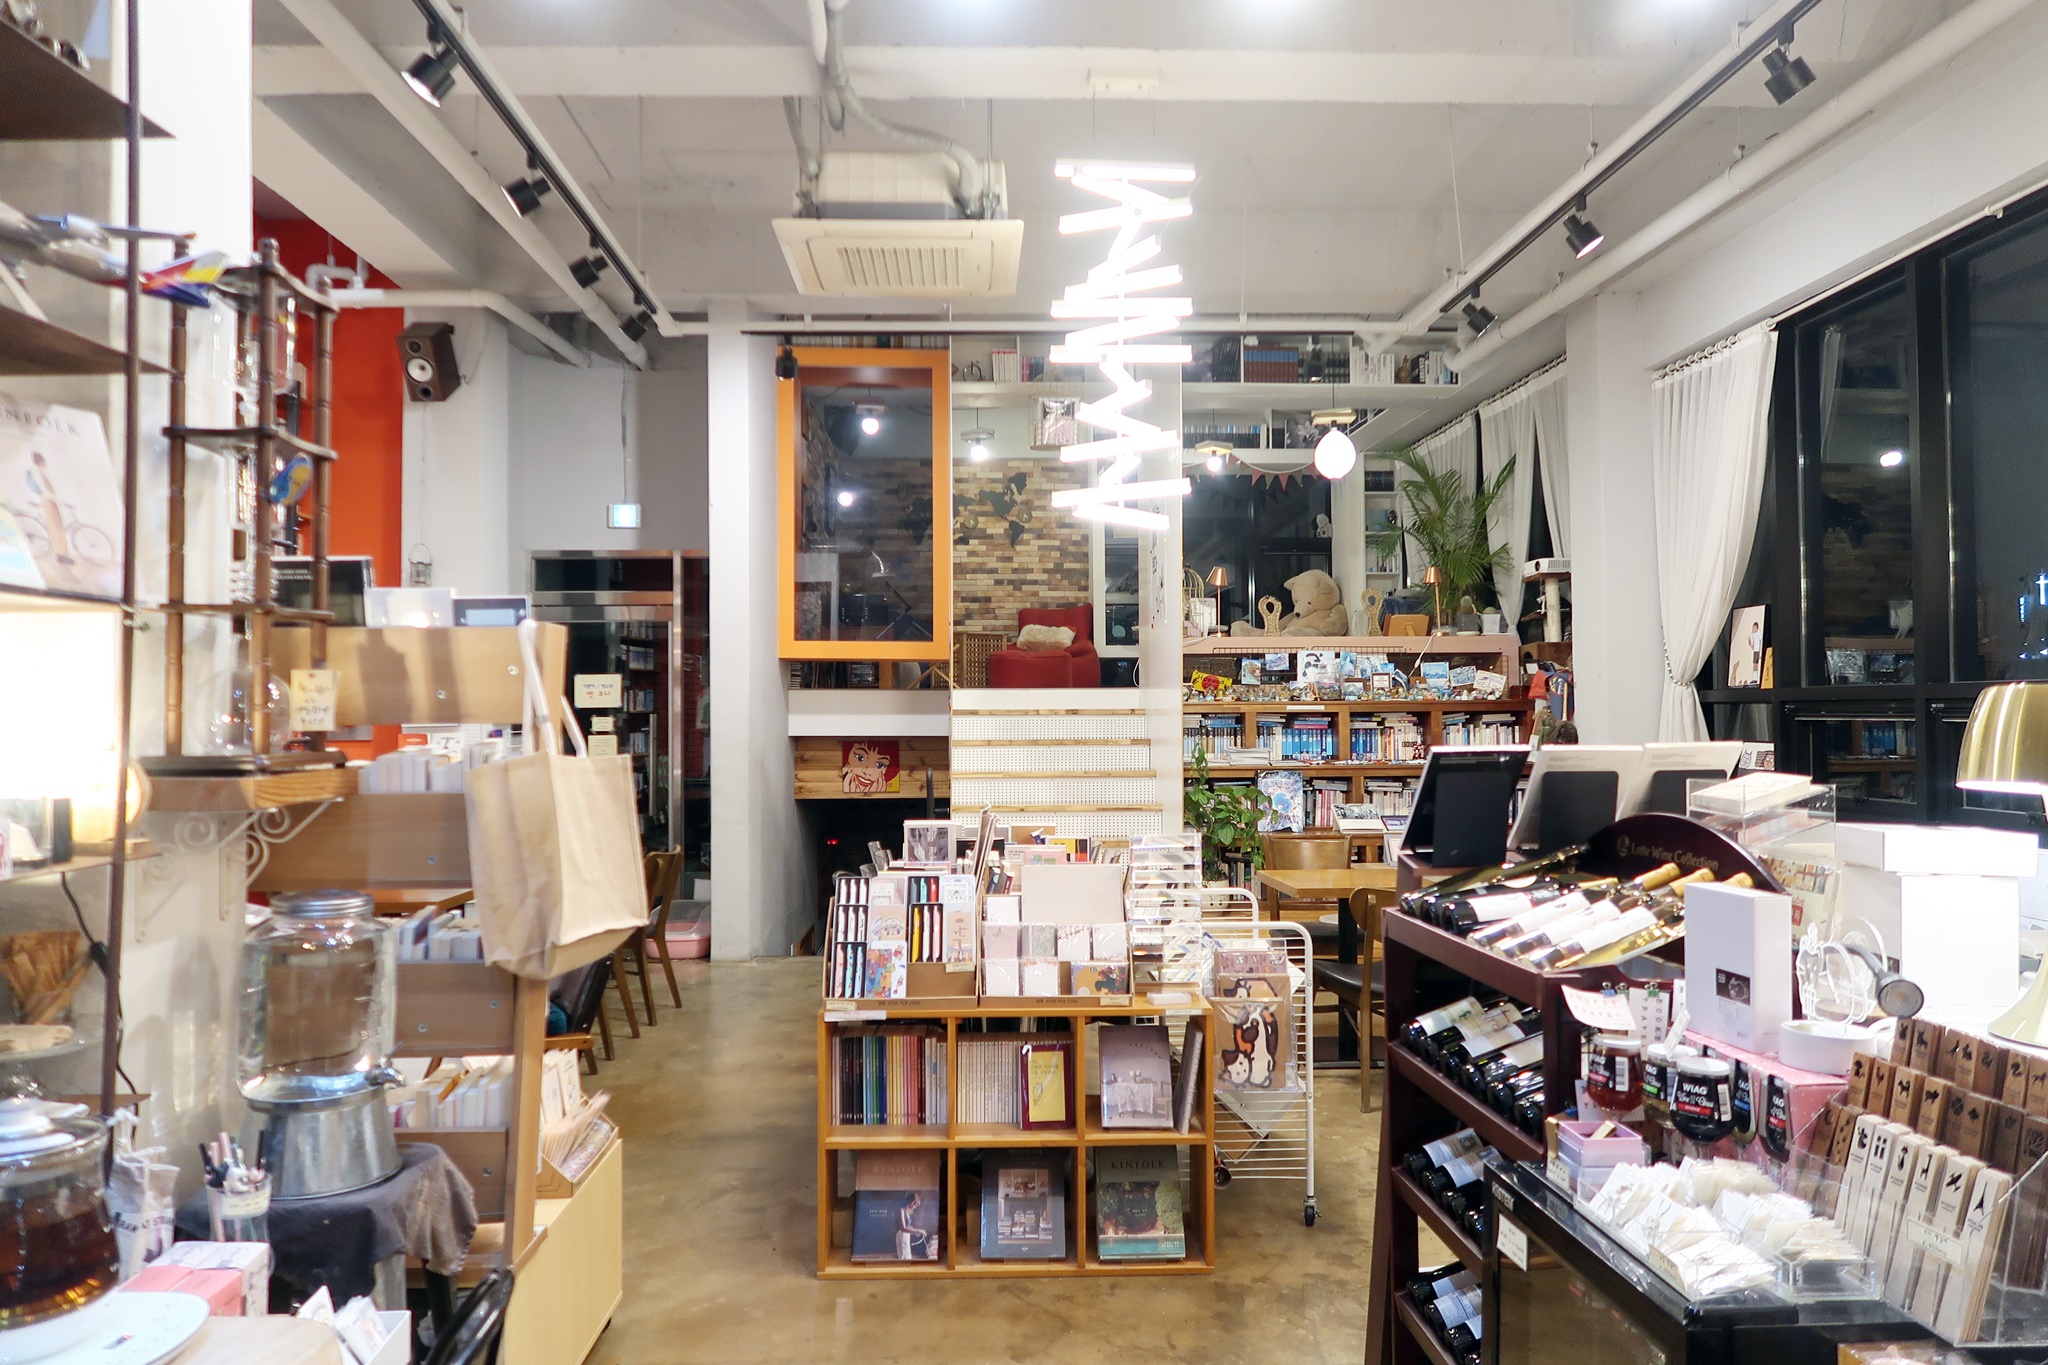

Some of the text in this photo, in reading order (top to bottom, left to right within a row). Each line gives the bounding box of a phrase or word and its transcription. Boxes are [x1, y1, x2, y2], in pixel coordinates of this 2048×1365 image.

[1, 408, 80, 436] NFOLK
[1682, 1082, 1708, 1095] WIAG
[872, 1165, 925, 1174] KINFOLK
[1110, 1160, 1166, 1170] KINFOLK
